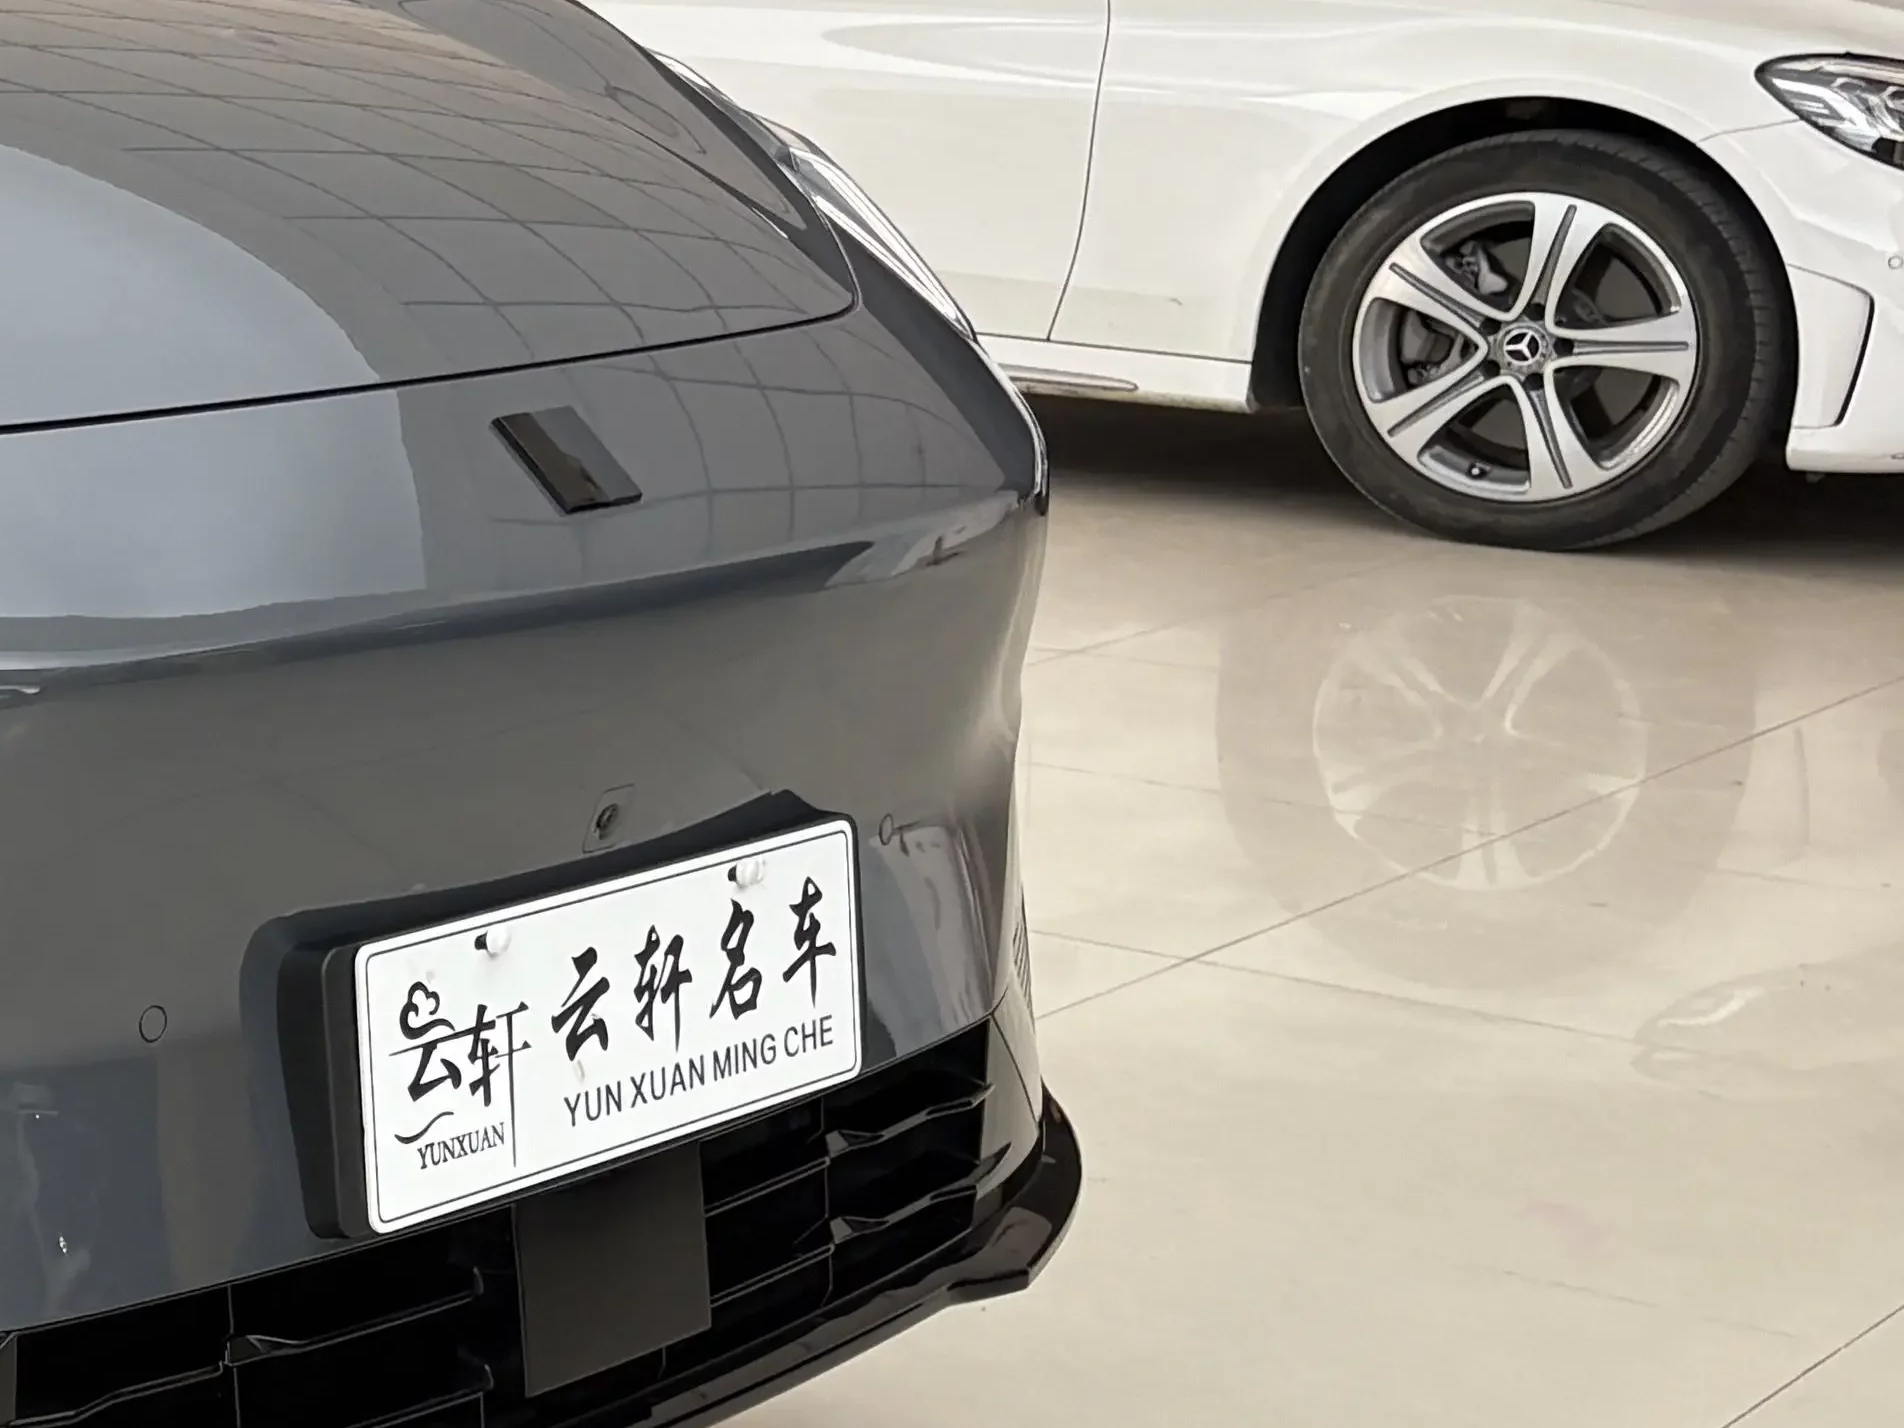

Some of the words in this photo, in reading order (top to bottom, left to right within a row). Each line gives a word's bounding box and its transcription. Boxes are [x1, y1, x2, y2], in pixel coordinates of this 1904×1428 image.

[551, 875, 837, 1061] 云轩名车
[563, 1081, 623, 1128] YUN
[629, 1056, 706, 1109] XUAN
[711, 1033, 777, 1081] MING
[783, 1014, 833, 1057] CHE
[416, 1122, 506, 1170] YUNXUAN
